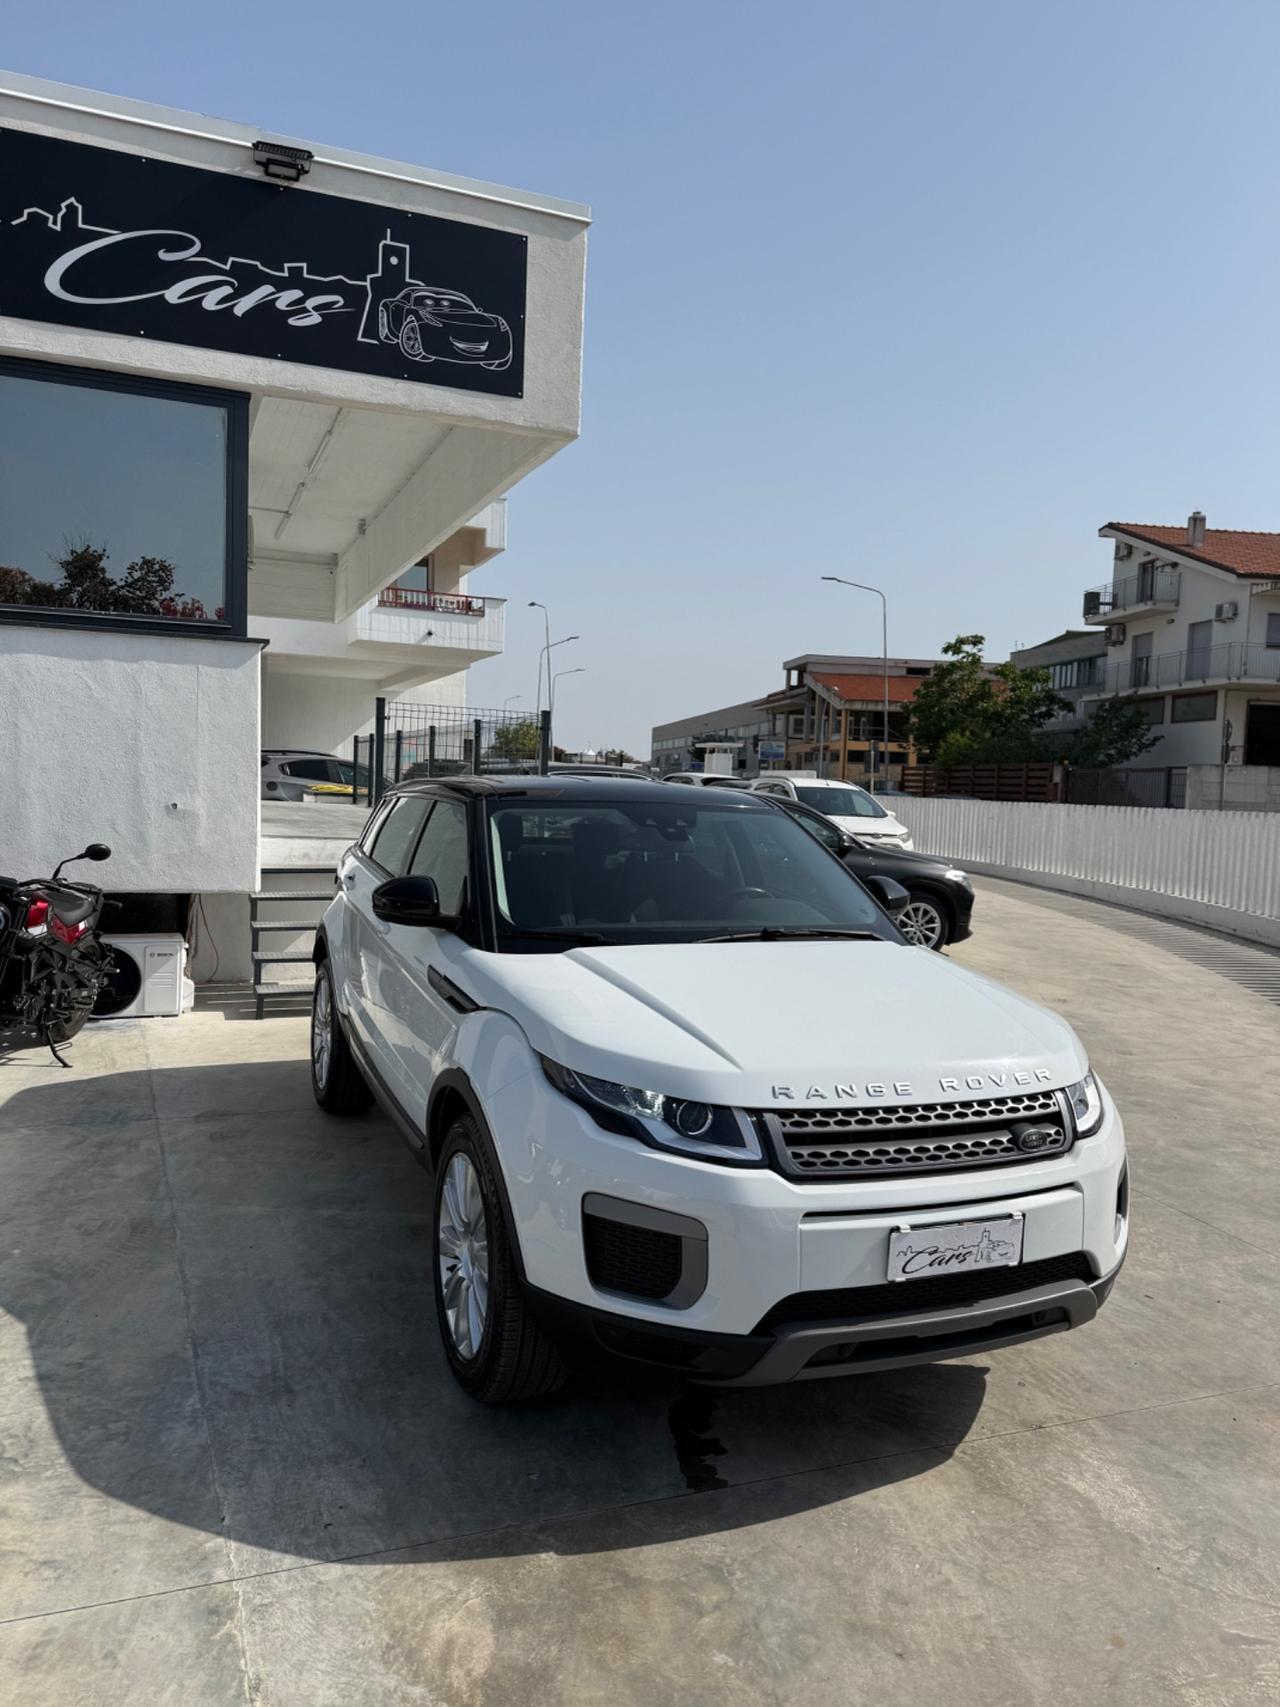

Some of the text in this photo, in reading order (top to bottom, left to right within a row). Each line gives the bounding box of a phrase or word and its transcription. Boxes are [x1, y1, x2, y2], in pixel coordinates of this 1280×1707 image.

[44, 229, 355, 327] Cars
[771, 1068, 1052, 1100] RANGE ROVER
[902, 1245, 973, 1275] Cars
